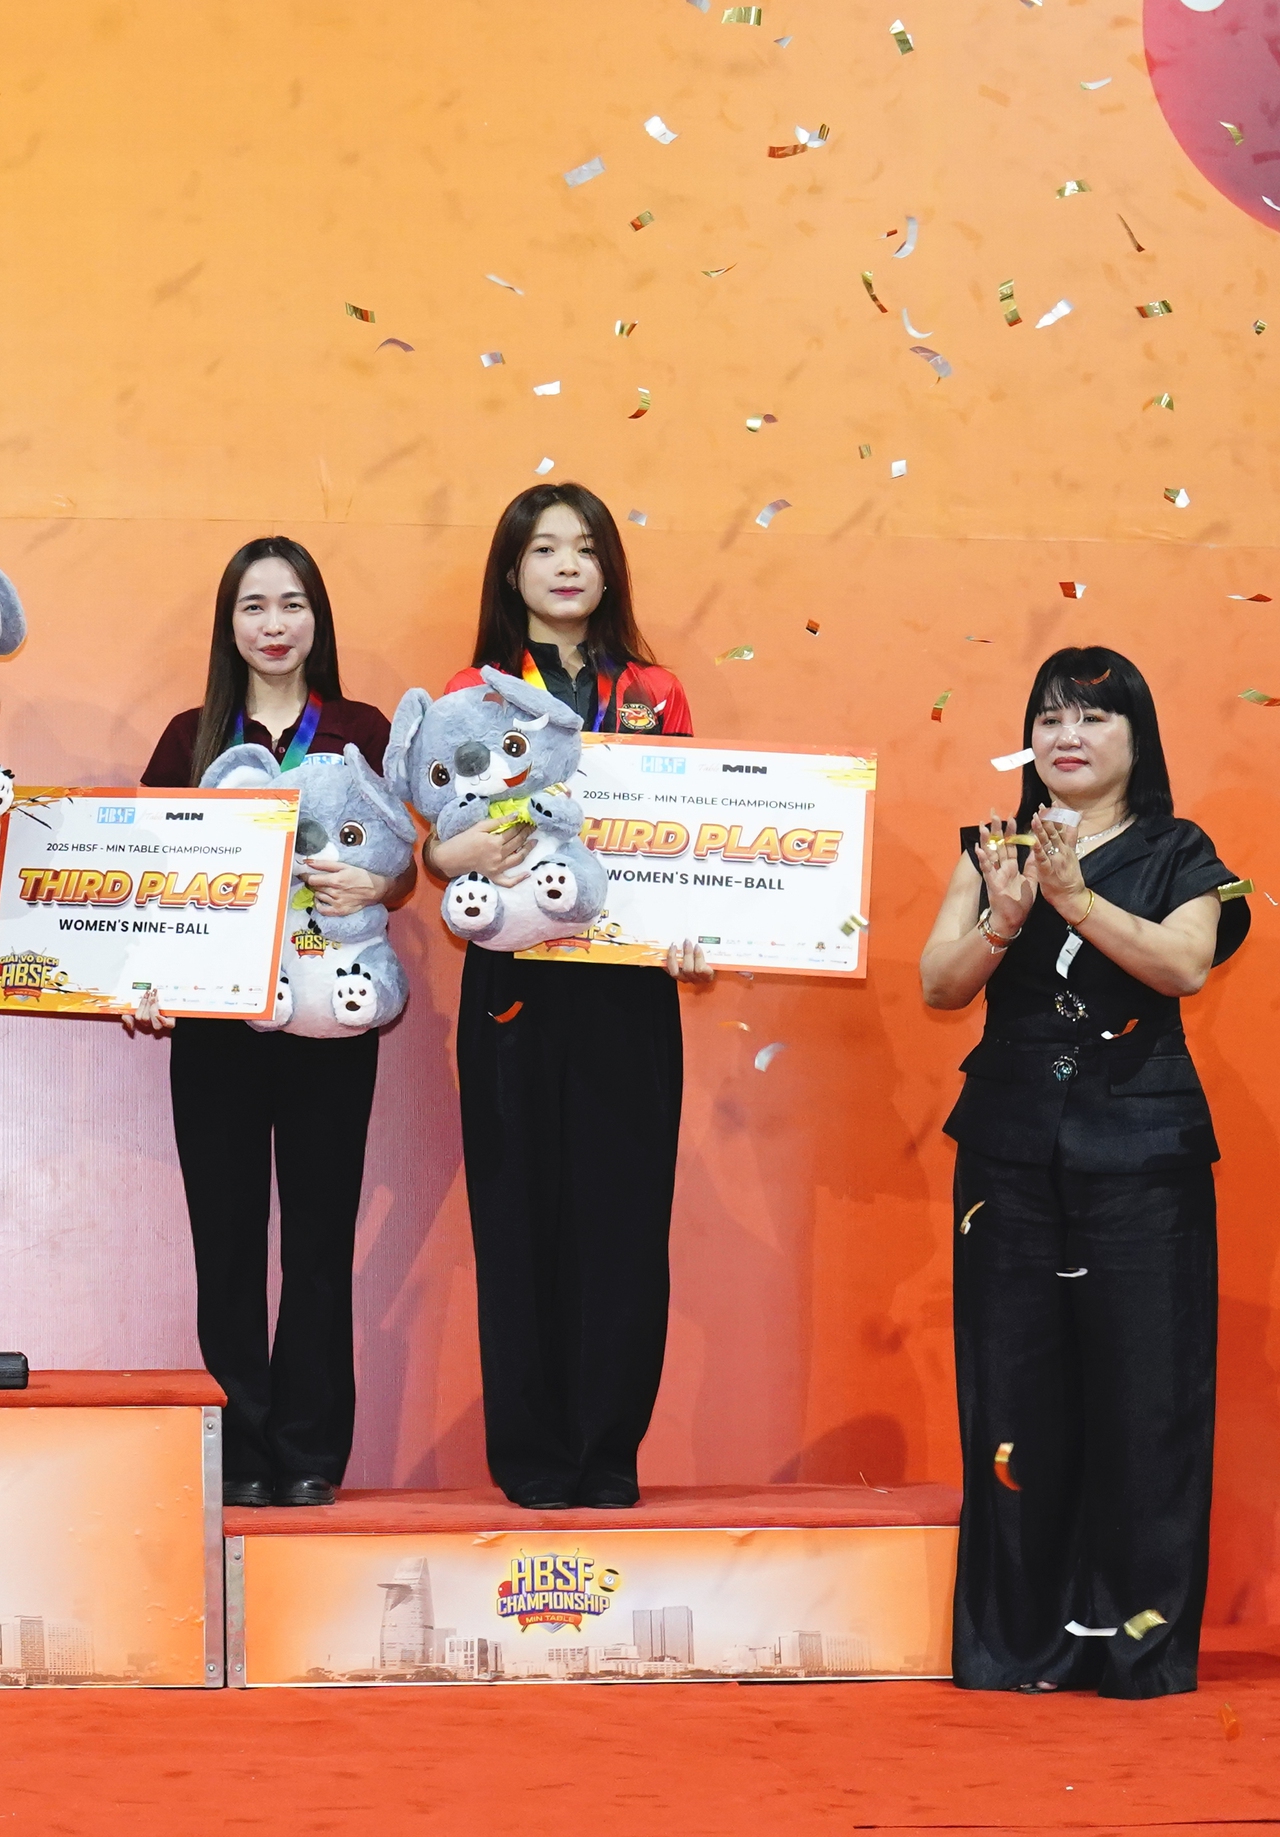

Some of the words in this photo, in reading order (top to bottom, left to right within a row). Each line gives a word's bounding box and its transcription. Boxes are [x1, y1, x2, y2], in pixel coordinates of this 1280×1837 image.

[642, 755, 686, 774] HBSF
[722, 764, 768, 775] MIN
[583, 790, 610, 800] 2025
[613, 792, 645, 802] HBSF
[654, 794, 677, 803] MIN
[680, 795, 718, 806] TABLE
[721, 797, 816, 811] CHAMPIONSHIP
[97, 807, 135, 824] HBSF
[166, 812, 204, 821] MIN
[46, 843, 69, 852] 2025
[71, 843, 97, 853] HBSF
[105, 844, 126, 853] MIN
[128, 845, 160, 854] TABLE
[162, 845, 242, 855] CHAMPIONSHIP
[578, 816, 690, 858] HIRD
[693, 823, 844, 867] PLACE
[19, 867, 134, 907] THIRD
[135, 870, 265, 909] PLACE
[604, 867, 689, 884] WOMEN'S
[693, 874, 785, 891] NINE-BALL
[58, 918, 129, 933] WOMEN'S
[132, 920, 210, 935] NINE-BALL
[1, 963, 53, 988] HBSF
[511, 1556, 595, 1594] HBSF
[496, 1591, 611, 1617] CHAMPIONSHIP
[525, 1615, 543, 1623] MIN
[544, 1615, 575, 1624] TABLE
